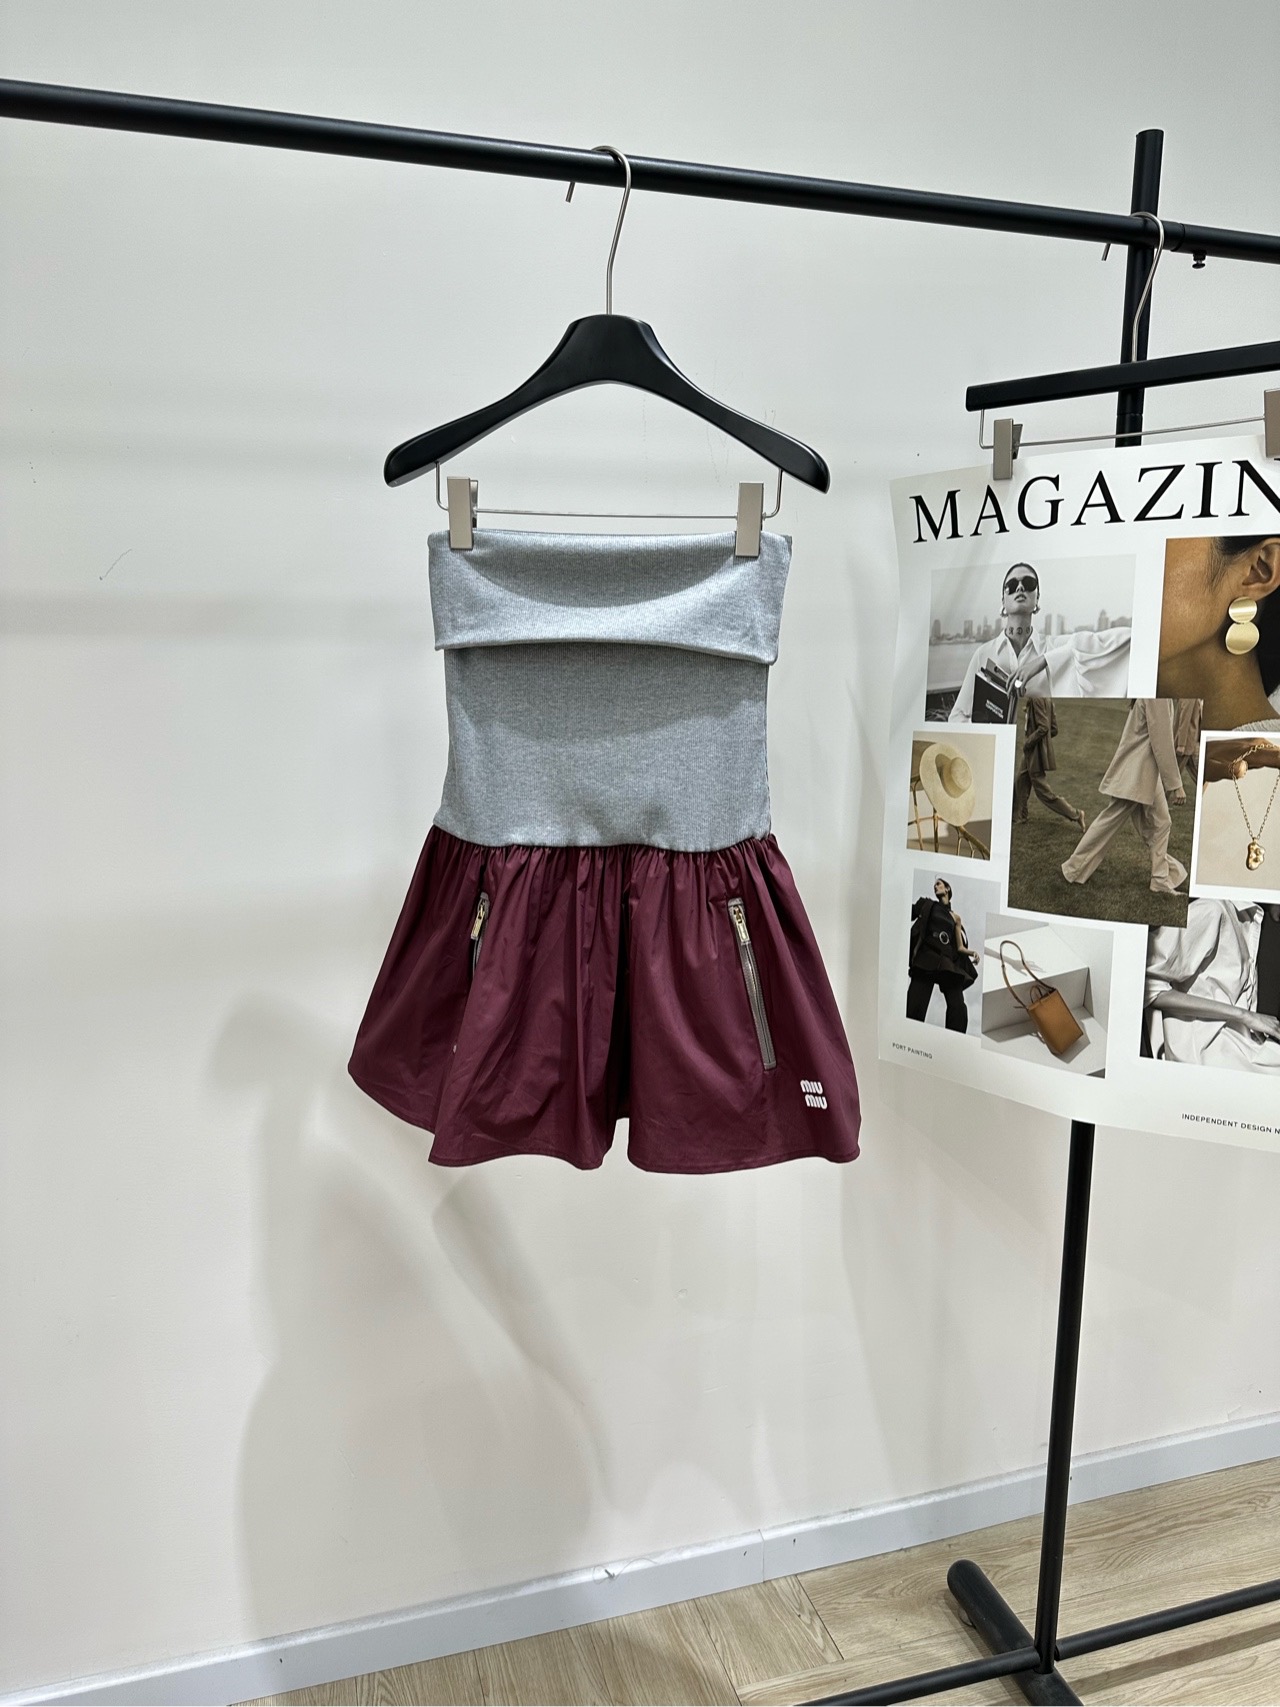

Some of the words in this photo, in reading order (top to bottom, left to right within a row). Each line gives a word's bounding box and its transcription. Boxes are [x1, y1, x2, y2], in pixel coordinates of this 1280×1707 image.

[909, 457, 1280, 544] MAGAZIN
[892, 1042, 906, 1051] PORT
[907, 1046, 933, 1059] PAINTING
[1181, 1113, 1238, 1127] INDEPENDENT
[1240, 1122, 1271, 1133] DESIGN
